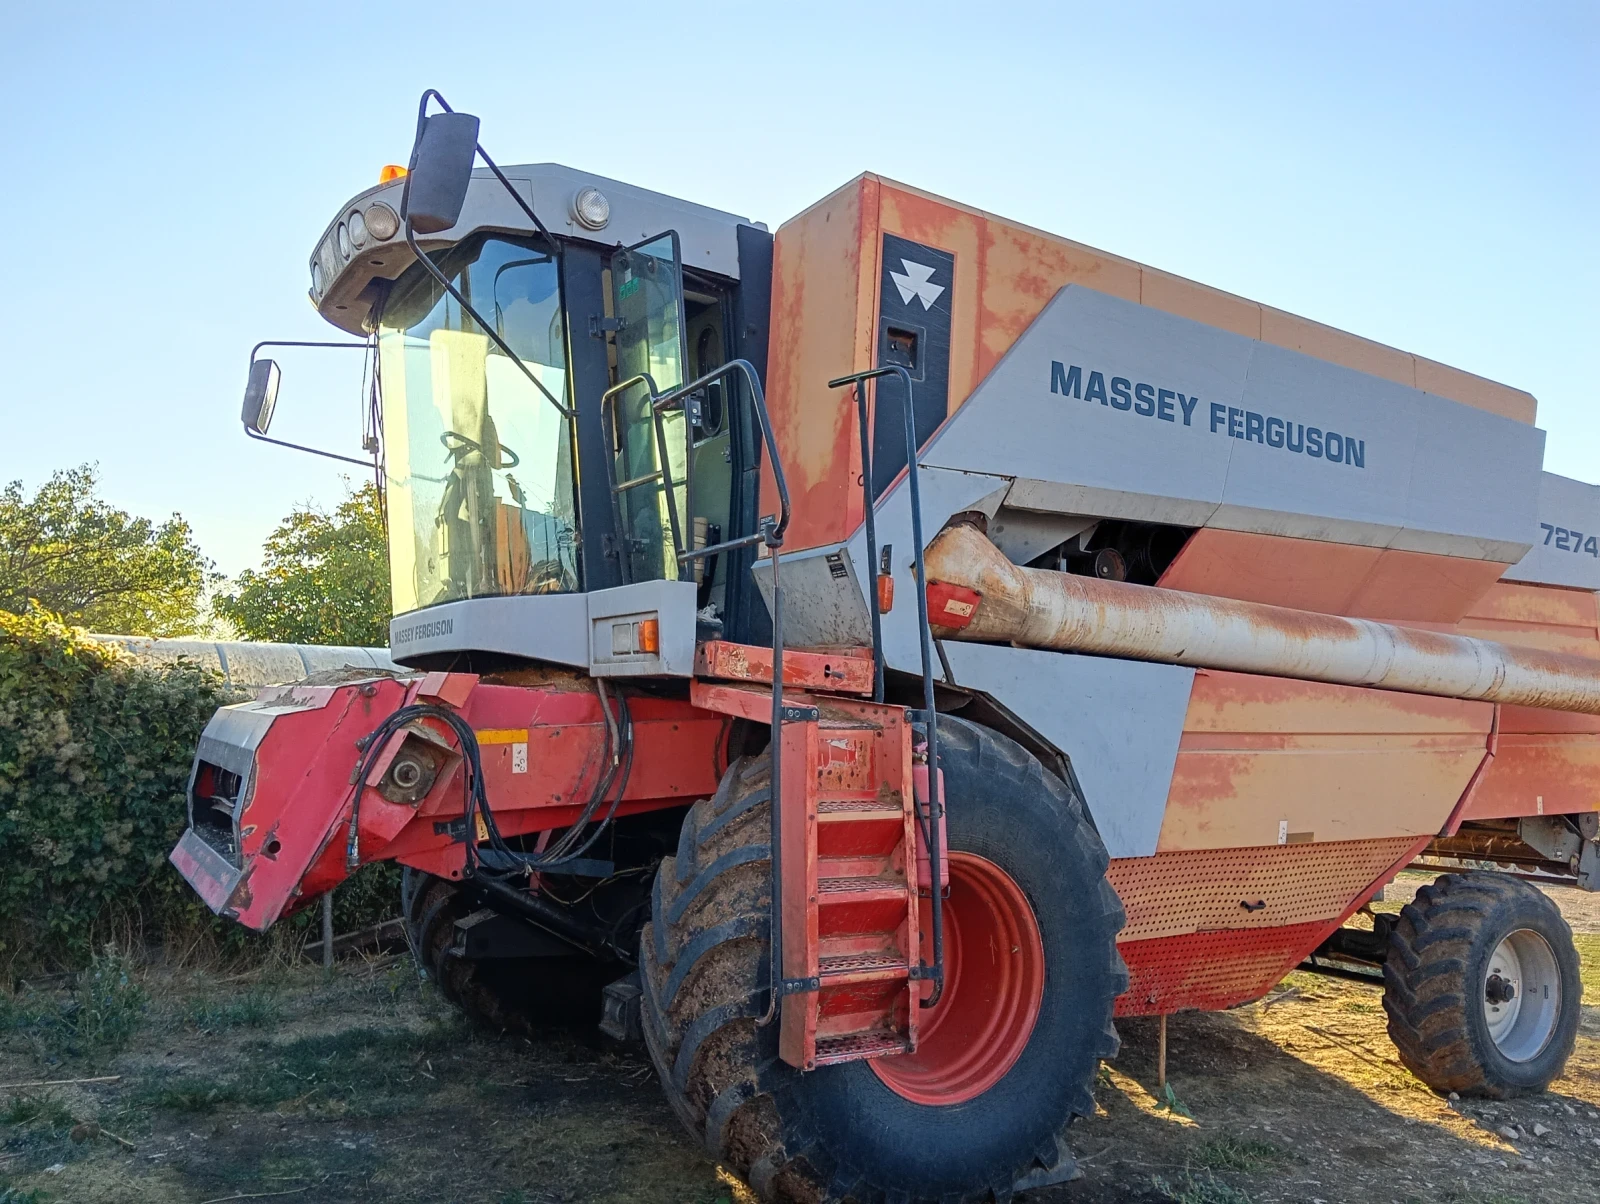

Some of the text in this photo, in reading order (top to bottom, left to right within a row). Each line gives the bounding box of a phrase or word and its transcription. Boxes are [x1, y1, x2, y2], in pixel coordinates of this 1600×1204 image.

[1050, 360, 1365, 468] MASSEY FERGUSON
[1540, 522, 1598, 558] 7274
[394, 618, 453, 645] MASSEY FERGUSON
